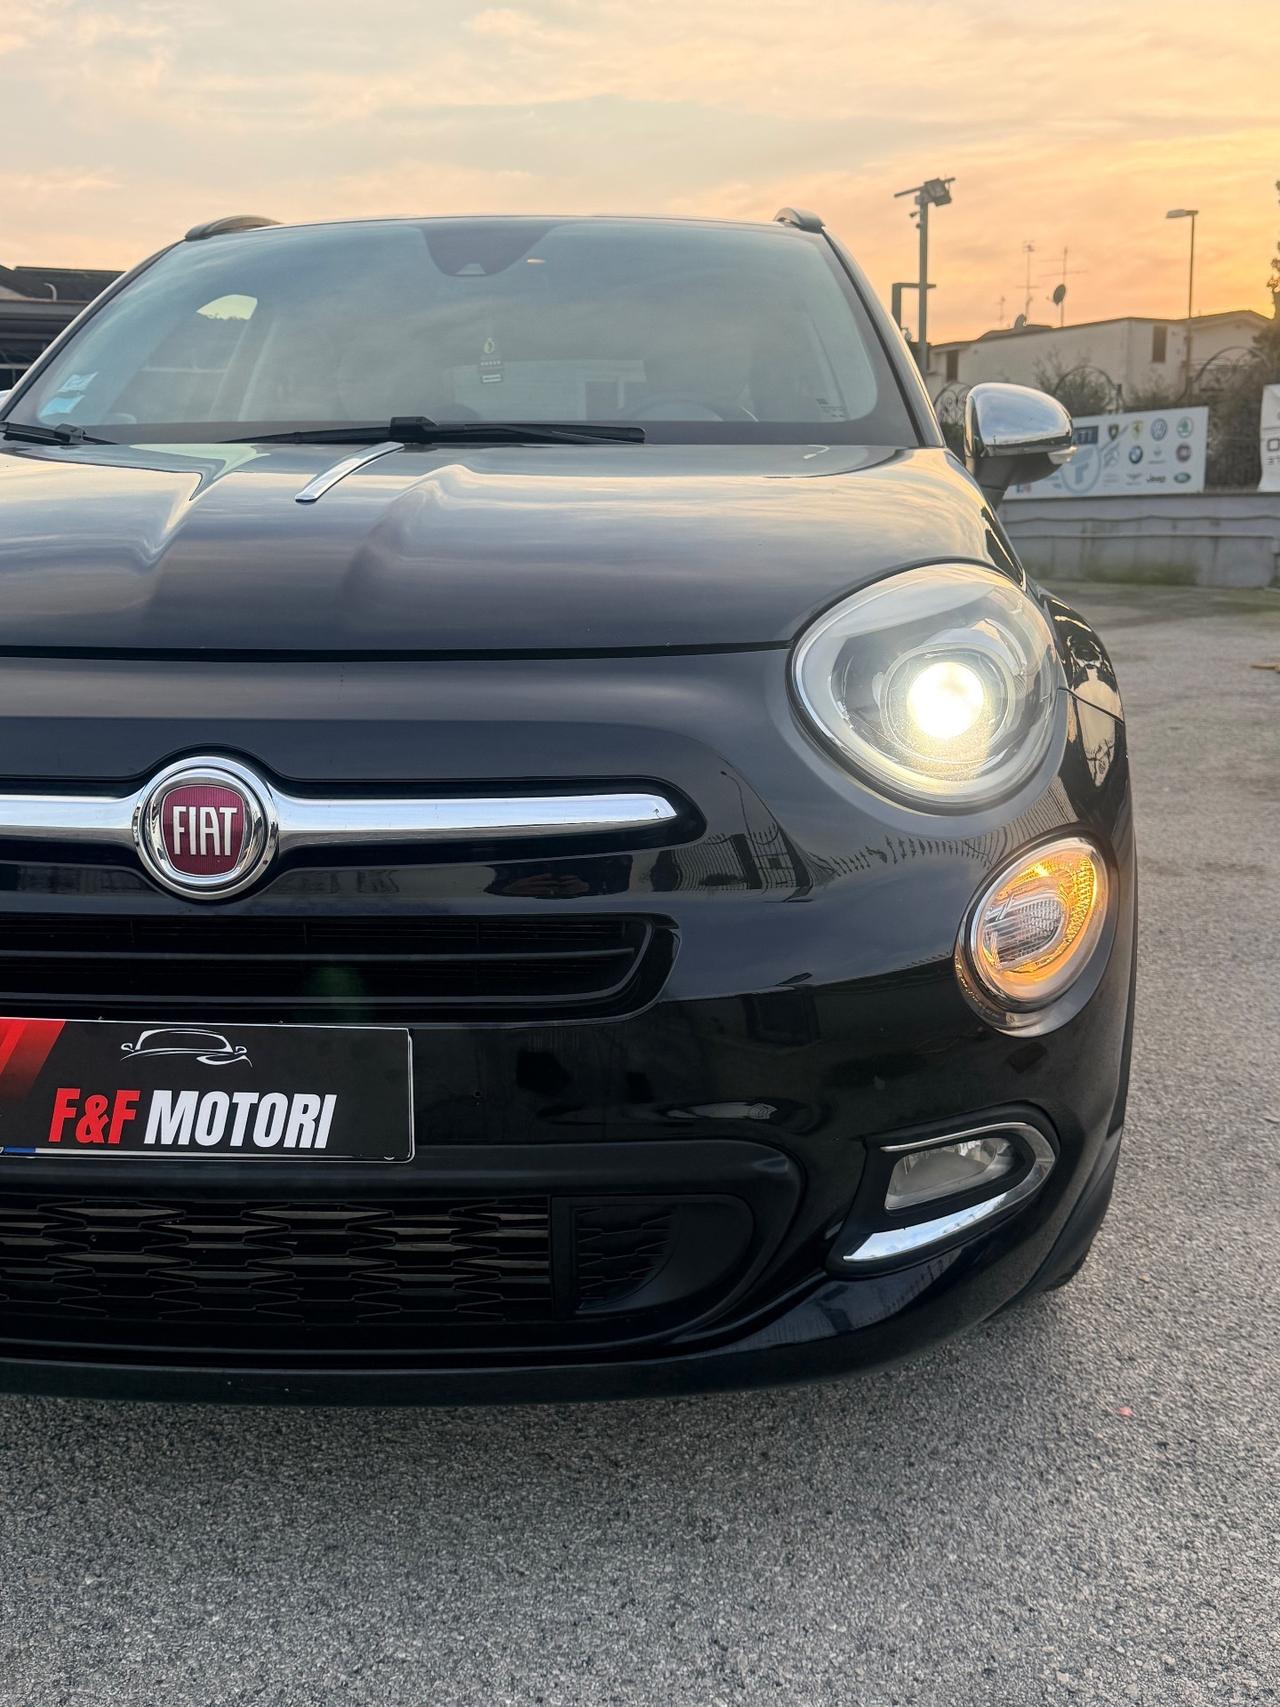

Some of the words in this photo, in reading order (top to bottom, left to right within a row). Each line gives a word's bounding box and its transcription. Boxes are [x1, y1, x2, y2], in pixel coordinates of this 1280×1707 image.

[173, 806, 237, 856] FIAT
[48, 1088, 141, 1145] F&F
[144, 1089, 337, 1149] MOTORI
